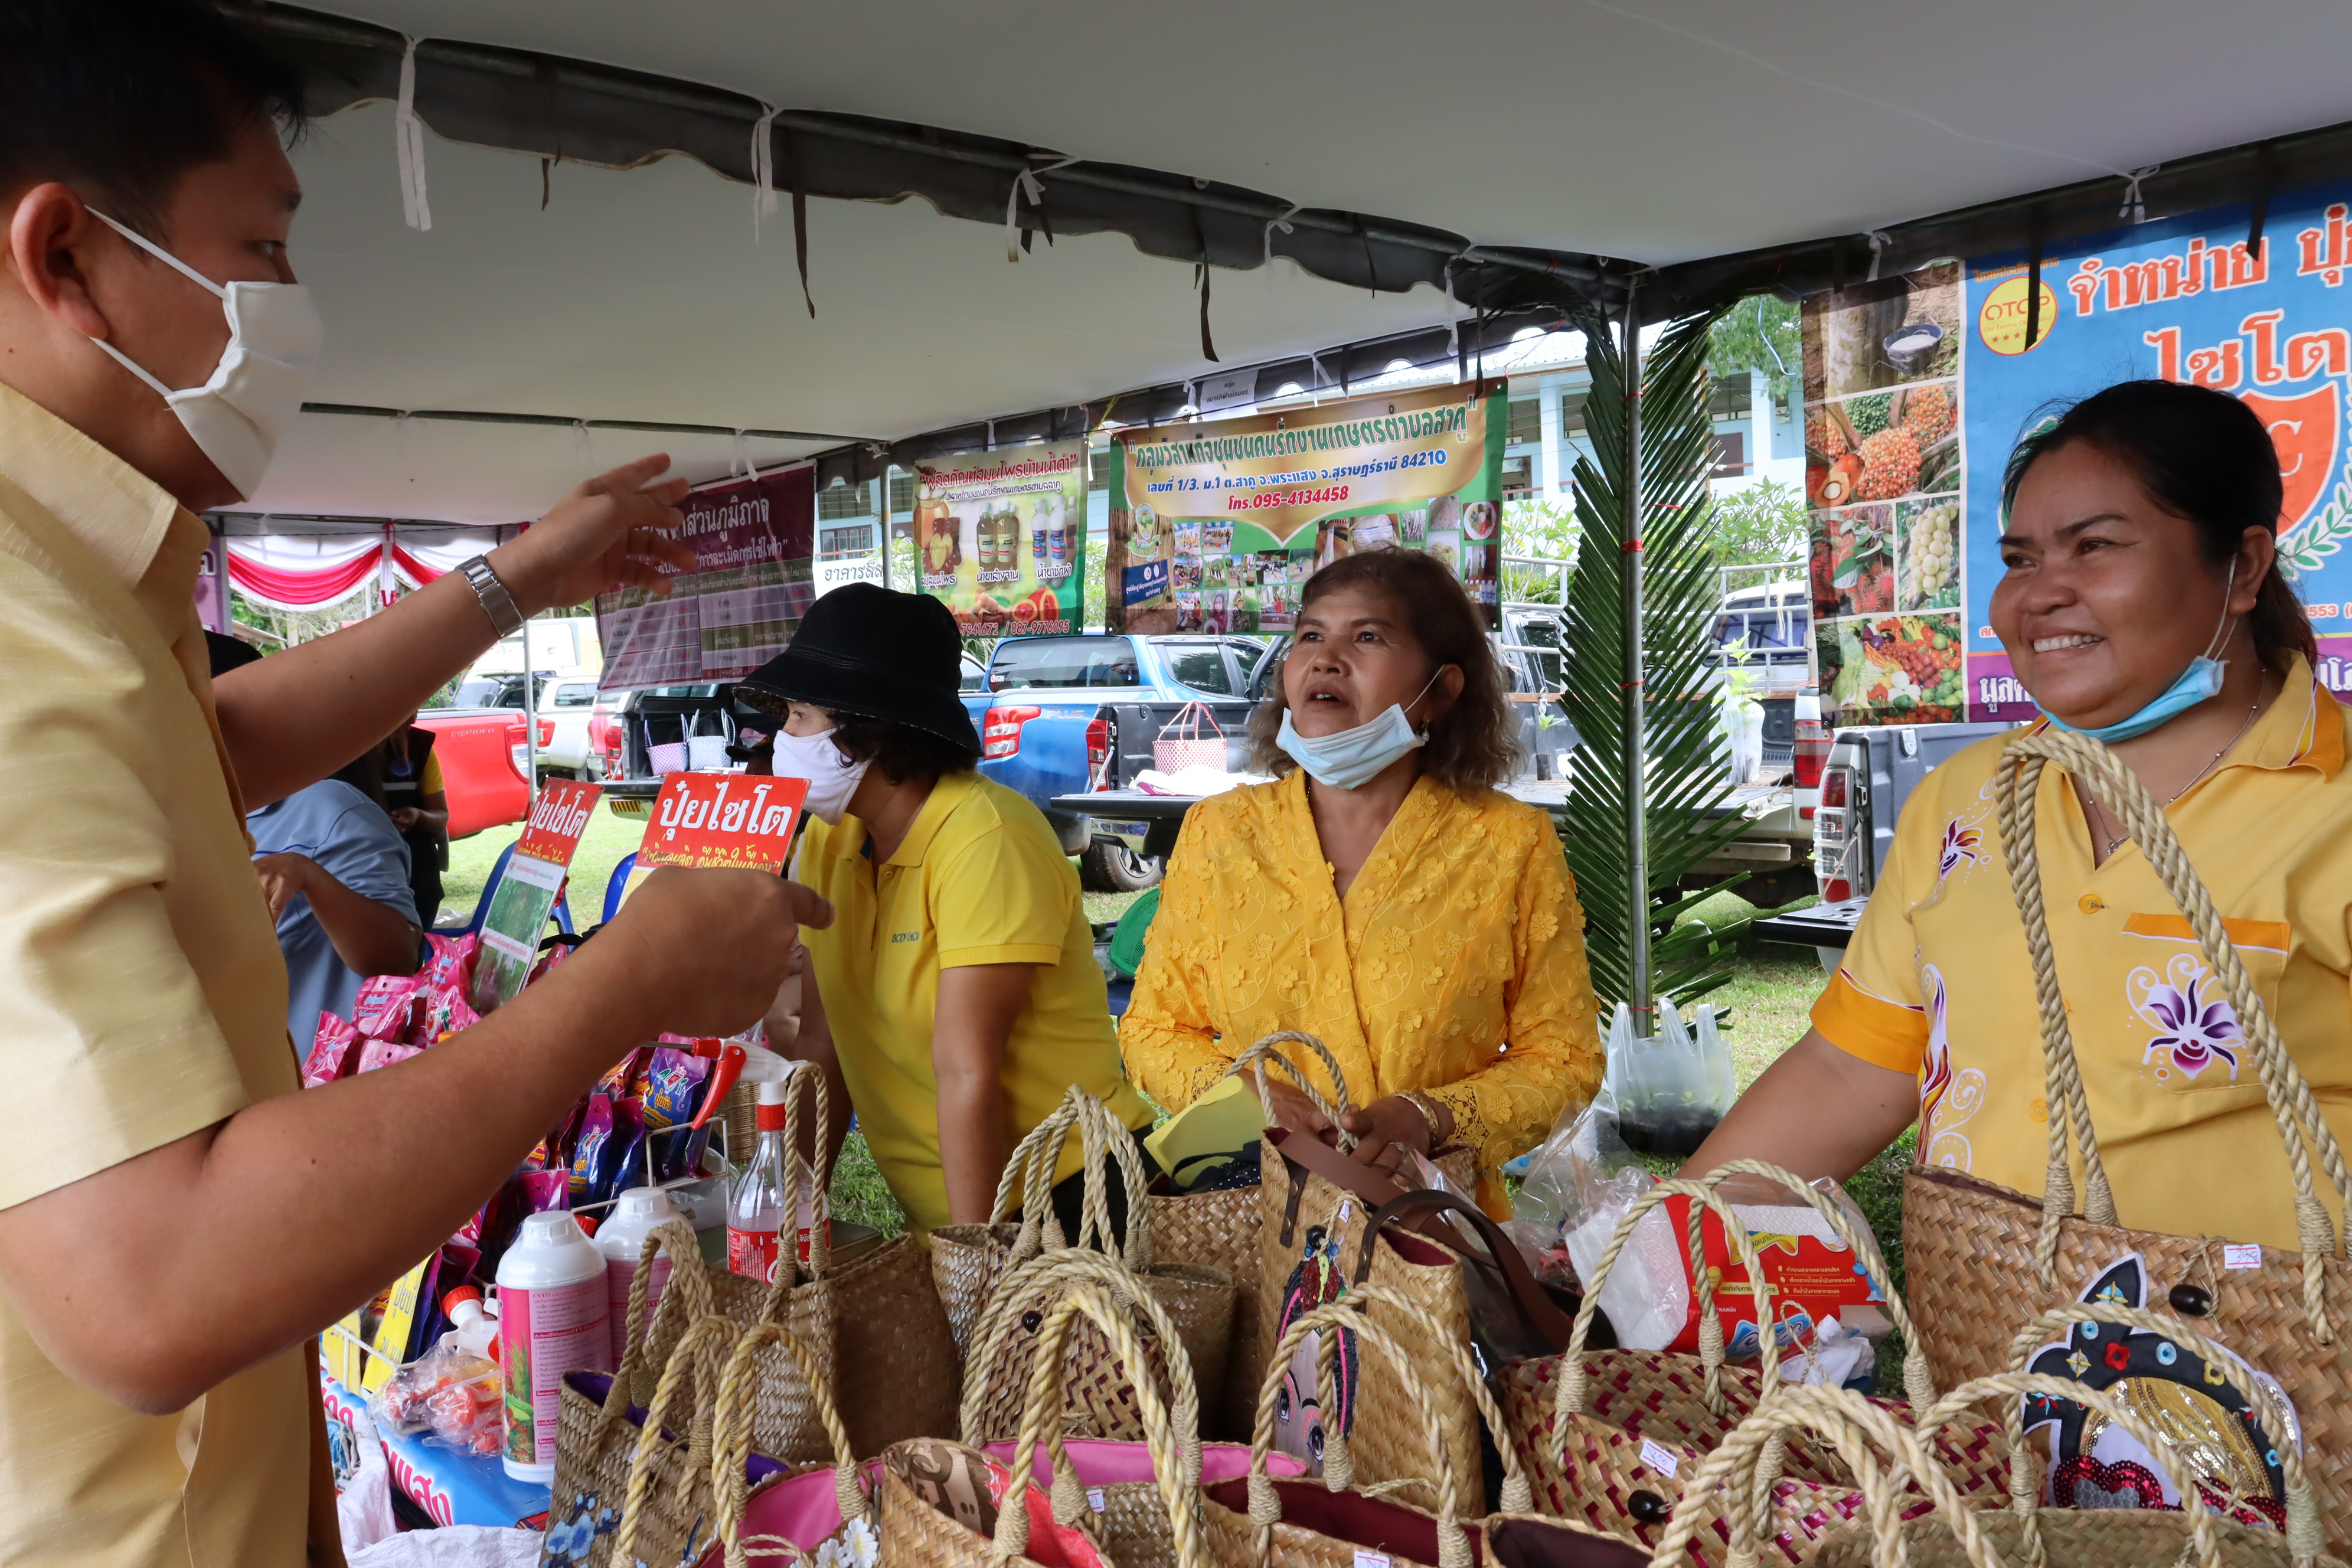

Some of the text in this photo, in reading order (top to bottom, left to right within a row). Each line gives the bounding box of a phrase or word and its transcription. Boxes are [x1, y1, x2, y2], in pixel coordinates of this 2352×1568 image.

[2069, 237, 2269, 317] จำหน่าย
[1997, 322, 2017, 330] Tambon
[2144, 309, 2351, 391] ไซโต
[1177, 478, 1199, 492] 1/3.
[1203, 476, 1220, 490] ม.1
[1224, 475, 1256, 491] ต.สาคู
[1259, 468, 1317, 486] อ.พระแสง
[1321, 456, 1398, 482] จ.สุราษฎร์ธานี
[1401, 449, 1447, 470] 84210
[1228, 485, 1349, 510] โทร.095-4134458
[921, 571, 956, 589] สบู่สมุนไพร
[977, 567, 1020, 583] น้ำยาล้างจาน
[2305, 605, 2337, 618] 553
[1011, 620, 1070, 635] 087-9776095
[1046, 710, 1084, 719] PLUS
[659, 780, 792, 841] ปุ๋ยไซโต
[891, 932, 906, 943] BODY
